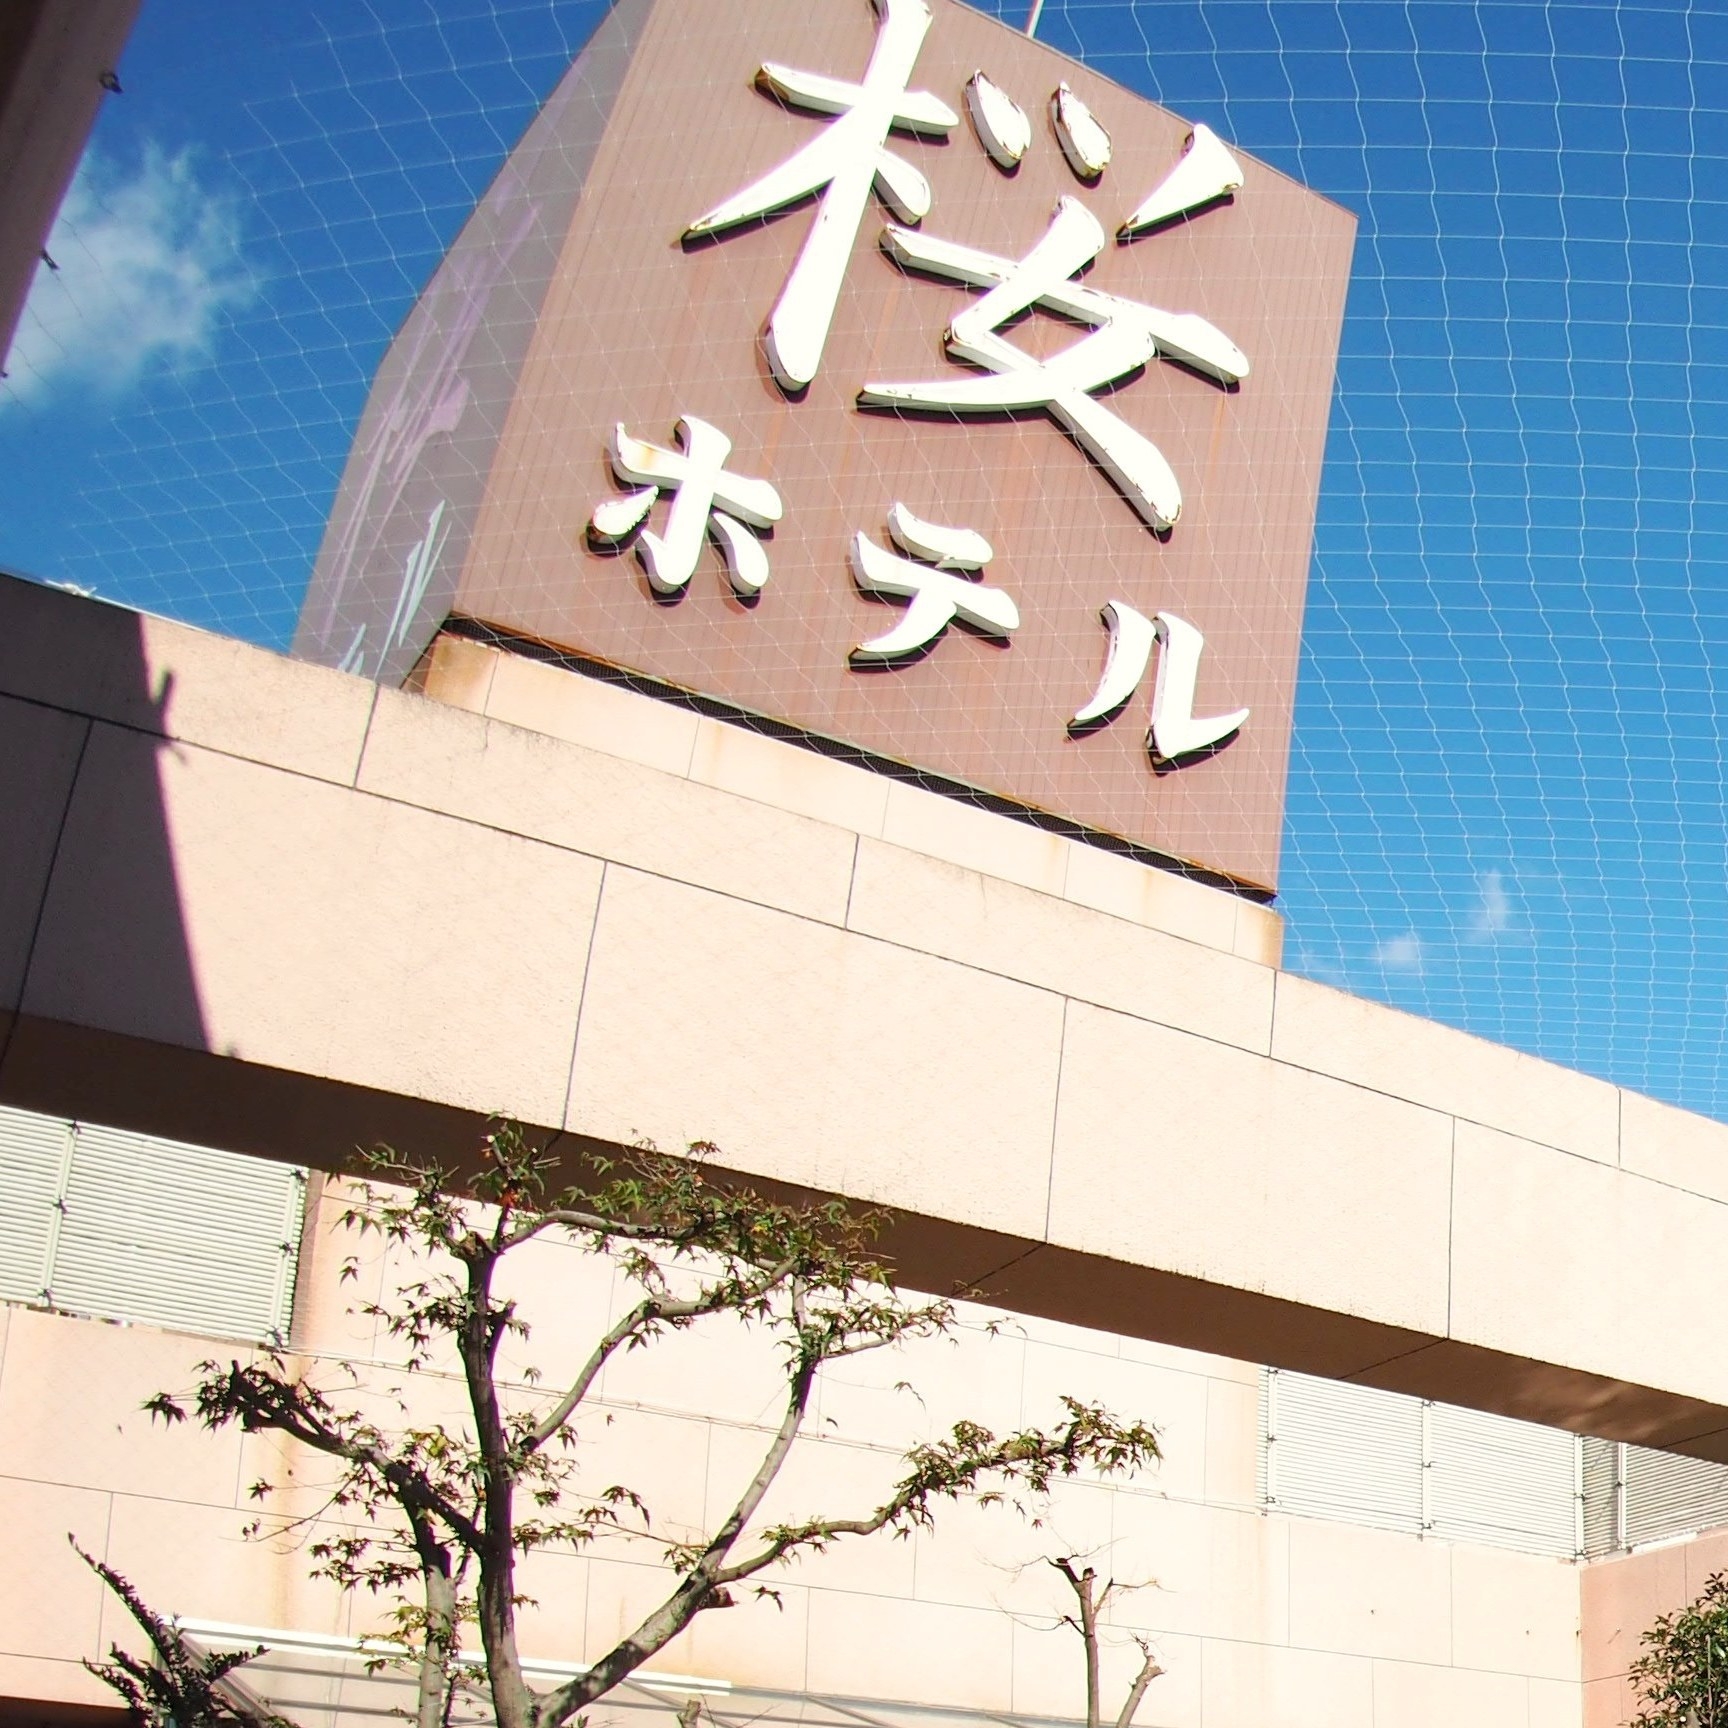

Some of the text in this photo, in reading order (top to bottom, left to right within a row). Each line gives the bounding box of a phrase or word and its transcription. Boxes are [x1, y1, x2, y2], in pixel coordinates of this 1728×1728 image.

[682, 0, 1250, 530] 桜
[586, 414, 1250, 766] ホテル
